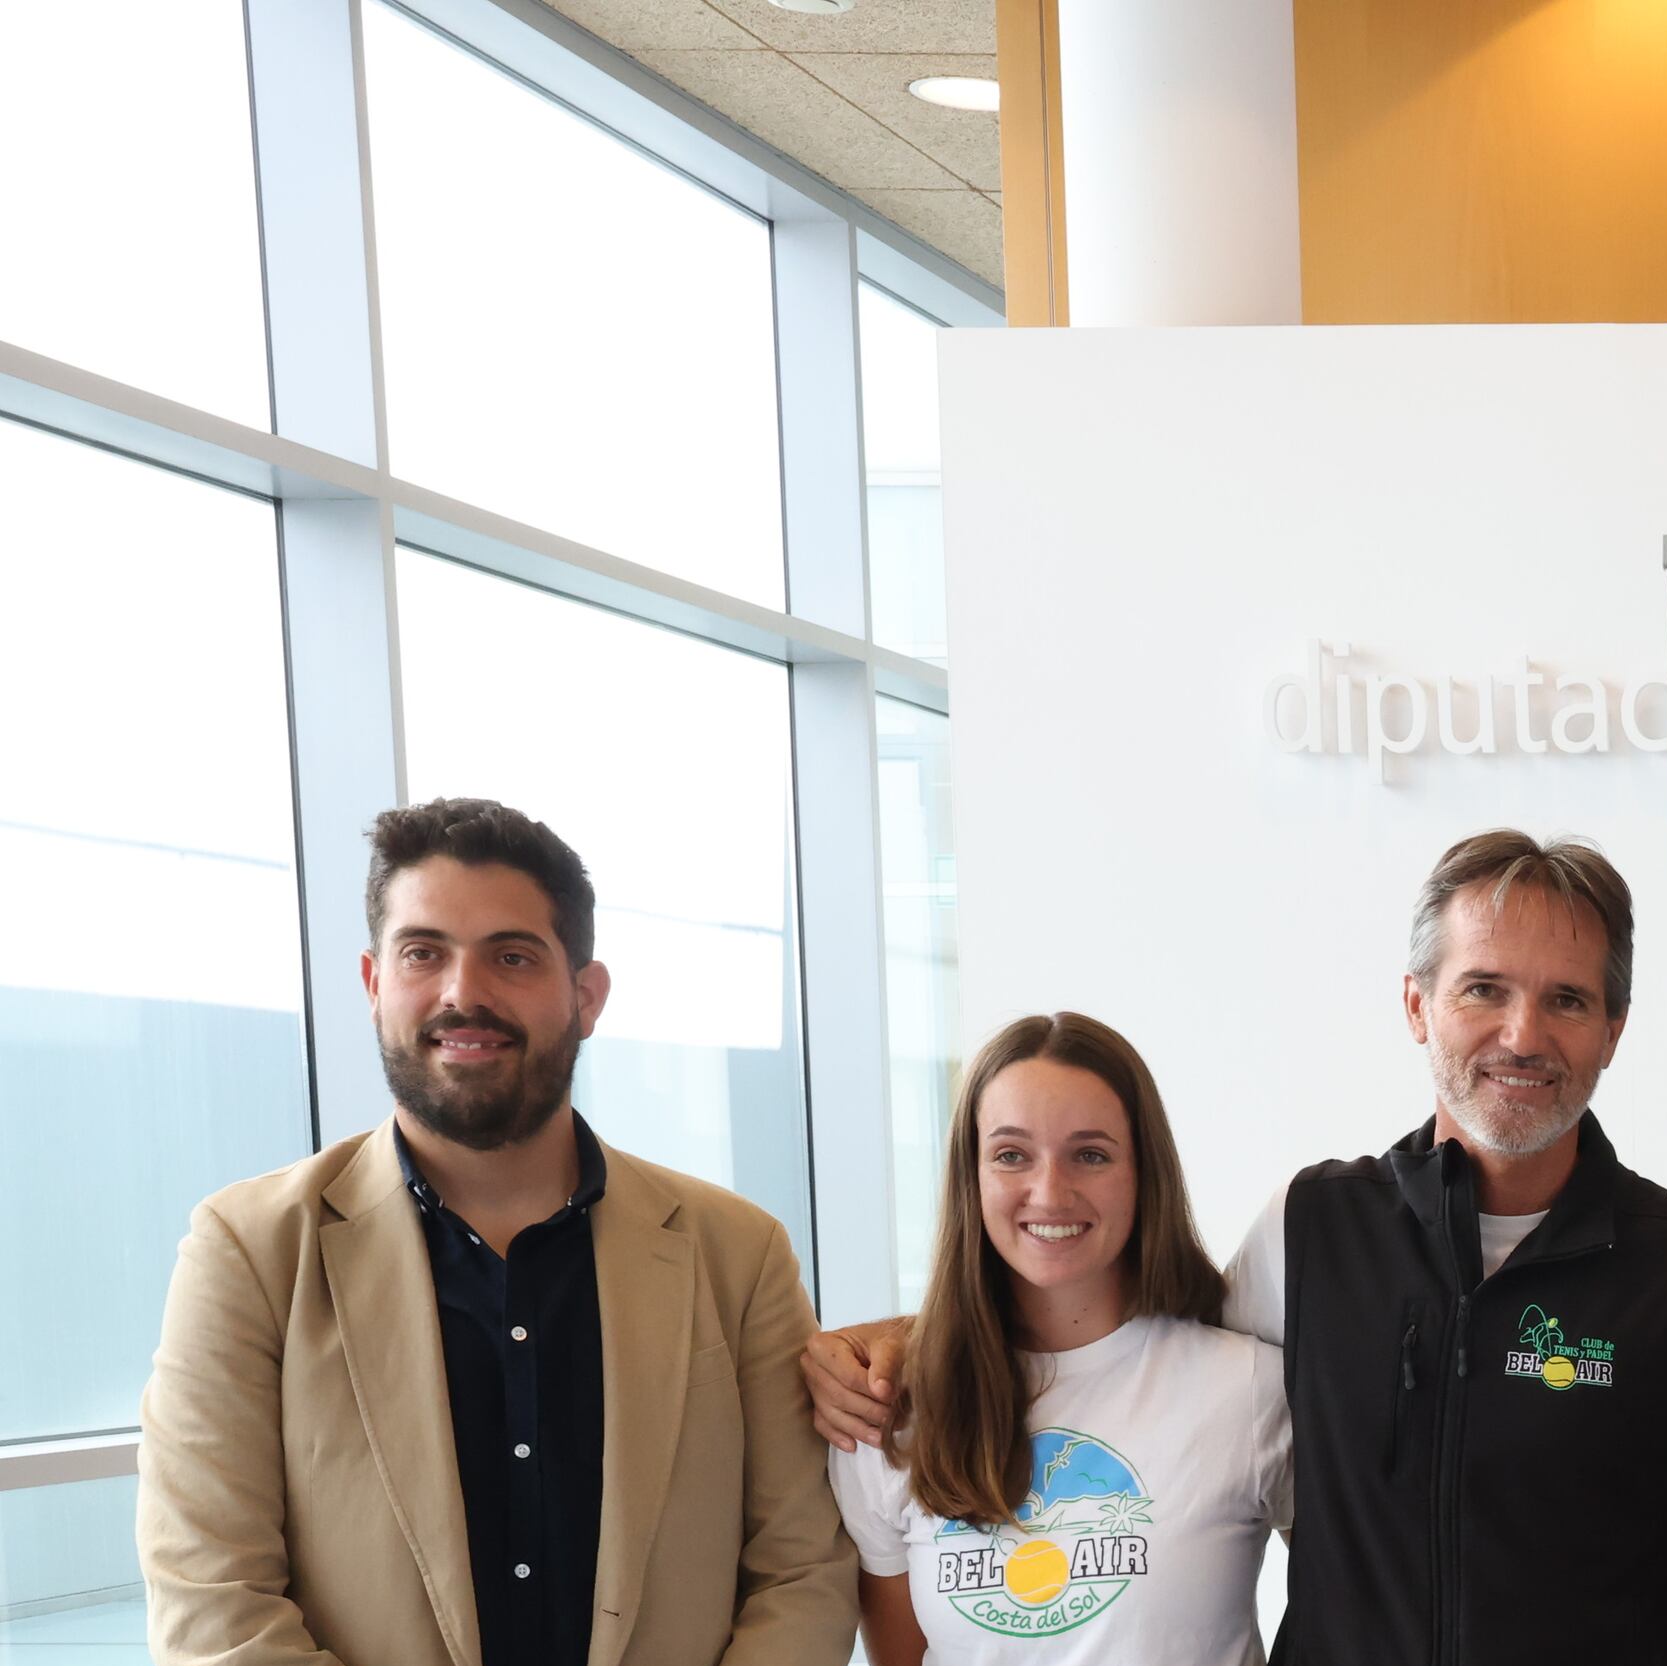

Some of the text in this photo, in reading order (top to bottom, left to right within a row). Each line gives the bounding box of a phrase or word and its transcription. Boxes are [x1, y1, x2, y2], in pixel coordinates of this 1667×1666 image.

[1553, 1344, 1580, 1358] TENIS
[1585, 1349, 1613, 1361] PADEL
[1580, 1337, 1615, 1350] CLUB de
[1505, 1352, 1613, 1385] BEL AIR
[937, 1535, 1148, 1593] BEL AIR
[972, 1586, 1101, 1630] Costa del Sol
